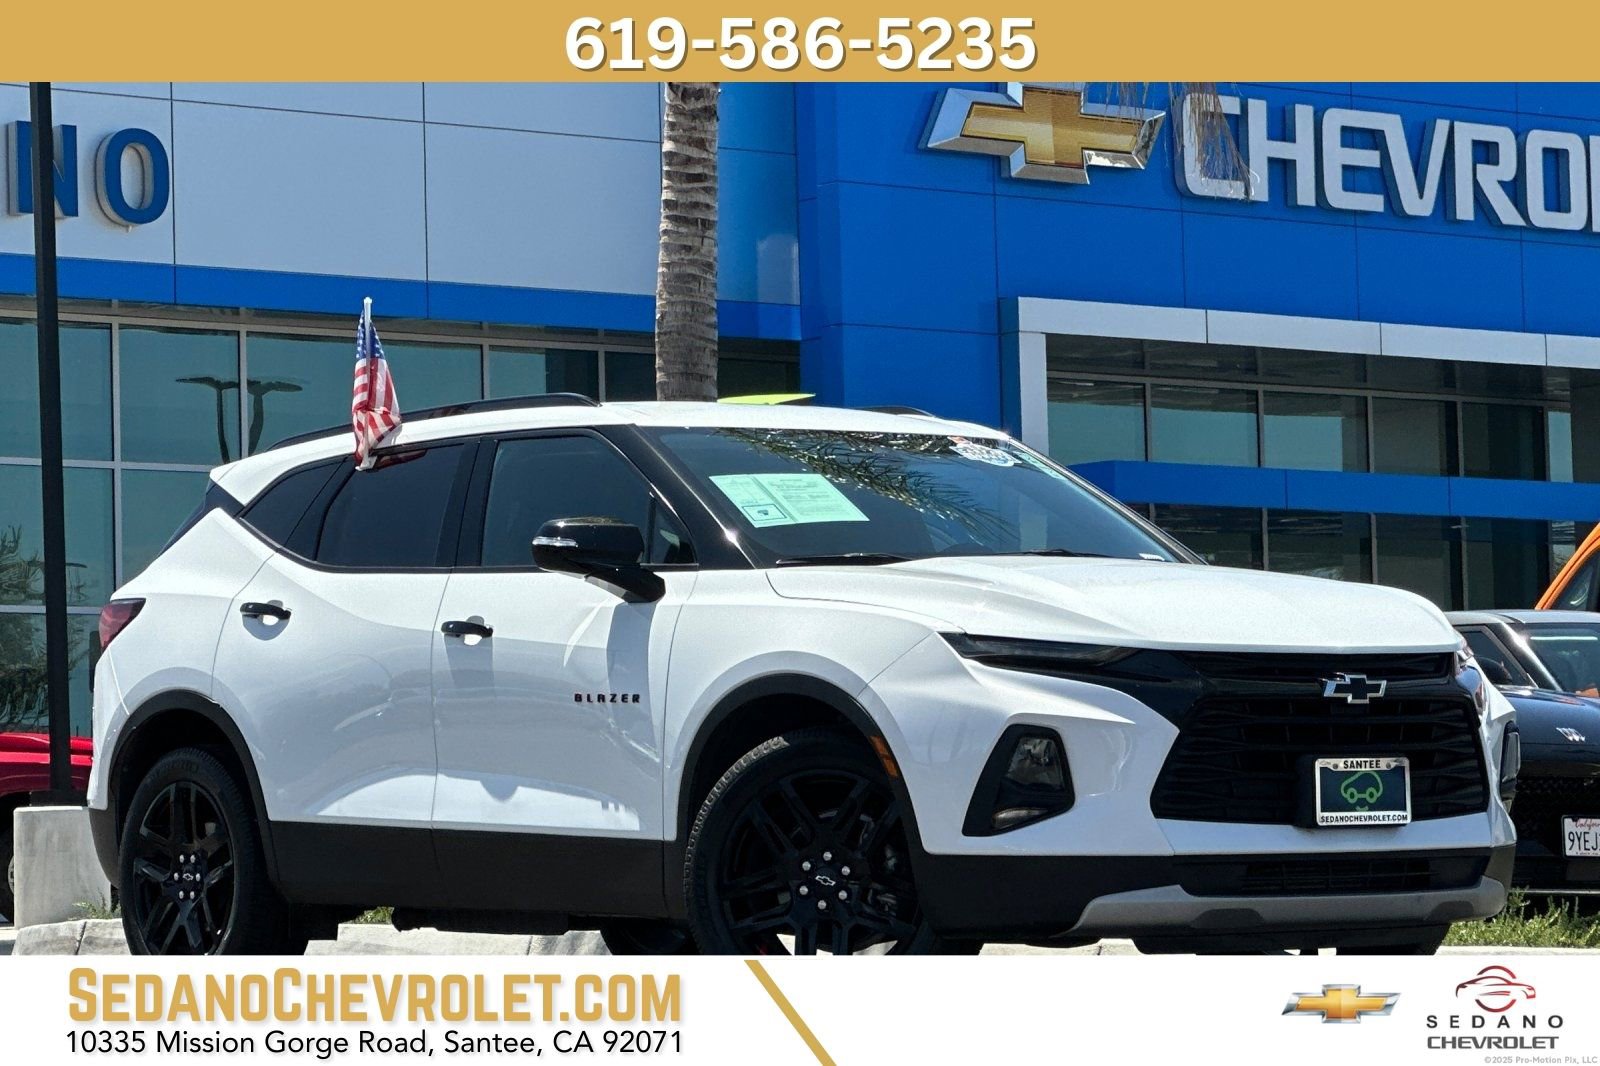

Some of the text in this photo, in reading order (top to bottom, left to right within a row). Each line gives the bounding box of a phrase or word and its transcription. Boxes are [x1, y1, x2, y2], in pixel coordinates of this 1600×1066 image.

[574, 693, 641, 703] BLAZER
[1343, 760, 1381, 769] SANTEE
[1320, 814, 1408, 823] SEDANOCHEVROLET.COM
[1568, 831, 1600, 851] 9YEJ
